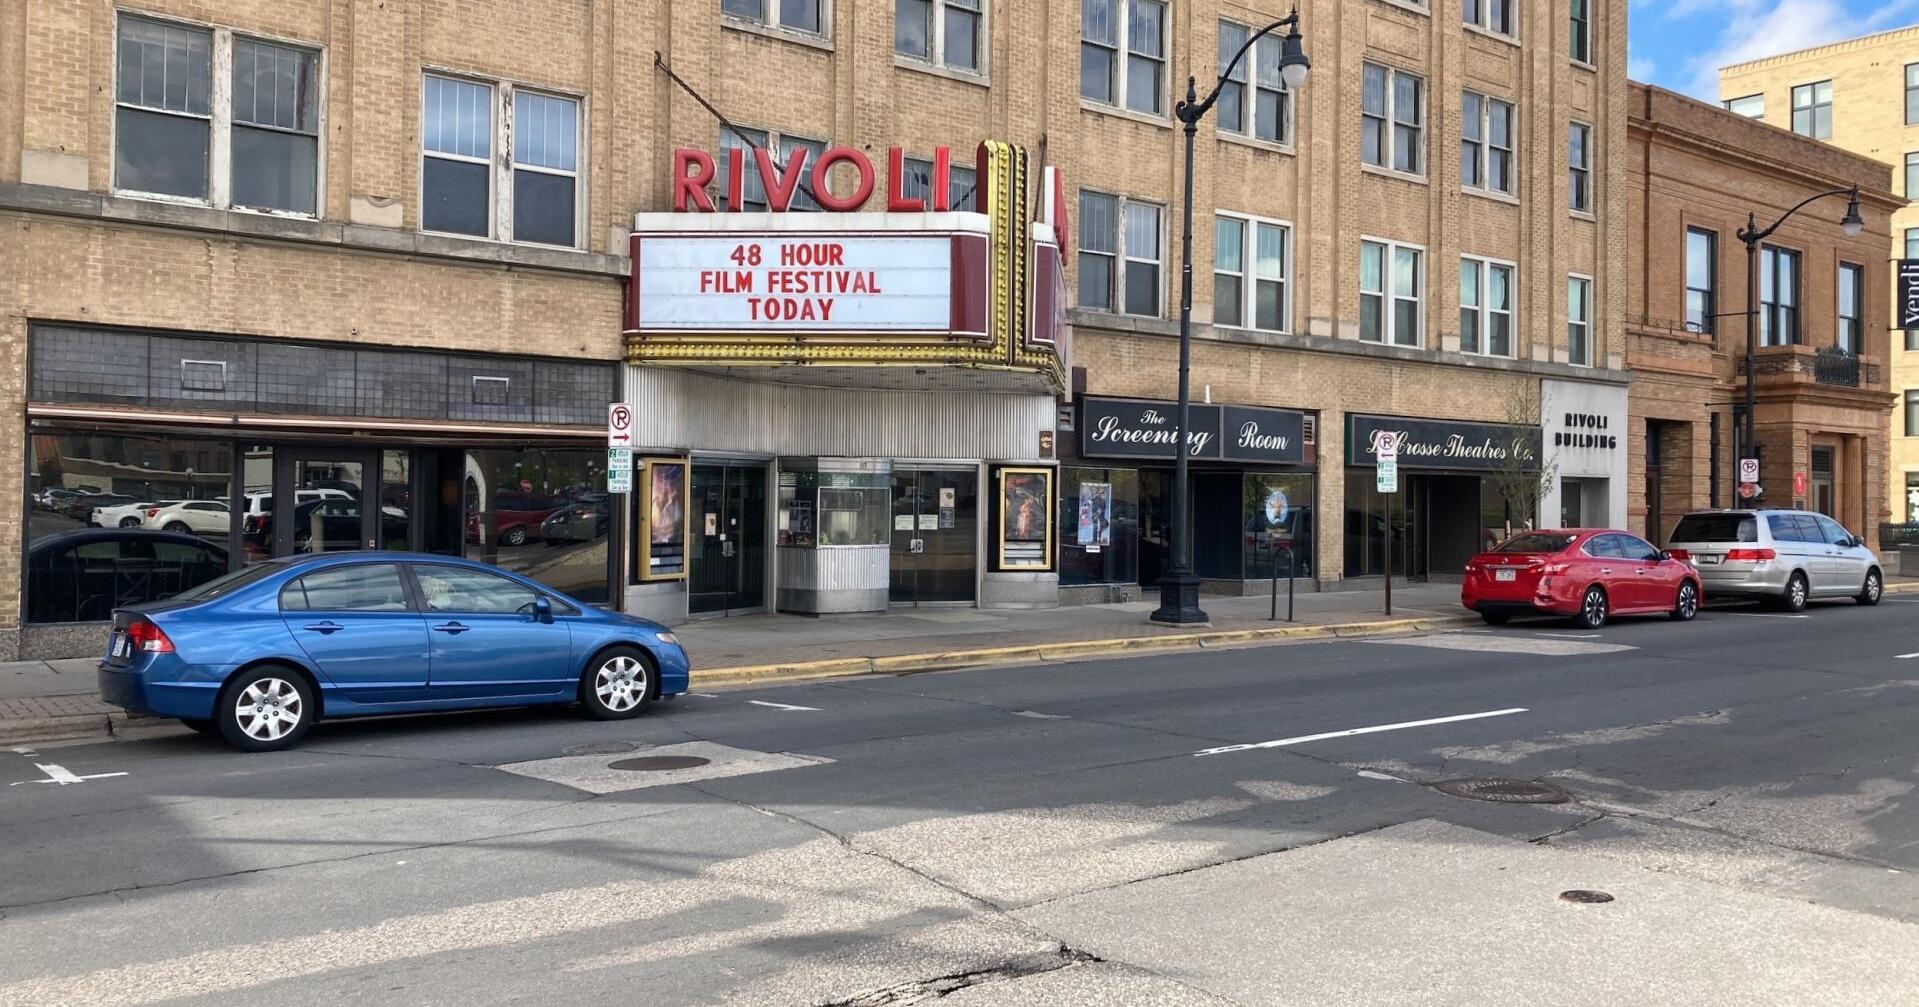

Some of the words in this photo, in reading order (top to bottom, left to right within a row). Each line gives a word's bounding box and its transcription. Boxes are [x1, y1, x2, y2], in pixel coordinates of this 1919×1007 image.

[674, 146, 950, 212] RIVOLI
[730, 244, 761, 267] 48
[780, 243, 844, 267] HOUR
[700, 270, 753, 294] FILM
[767, 270, 881, 295] FESTIVAL
[1901, 264, 1919, 327] vendi
[747, 298, 834, 321] TODAY
[1140, 409, 1167, 425] The
[1565, 412, 1608, 429] RIVOLI
[1238, 420, 1289, 450] Room
[1395, 431, 1442, 456] Crosse
[1444, 434, 1507, 461] Theatres
[1511, 437, 1534, 461] Co.
[1555, 432, 1617, 450] BUILDING
